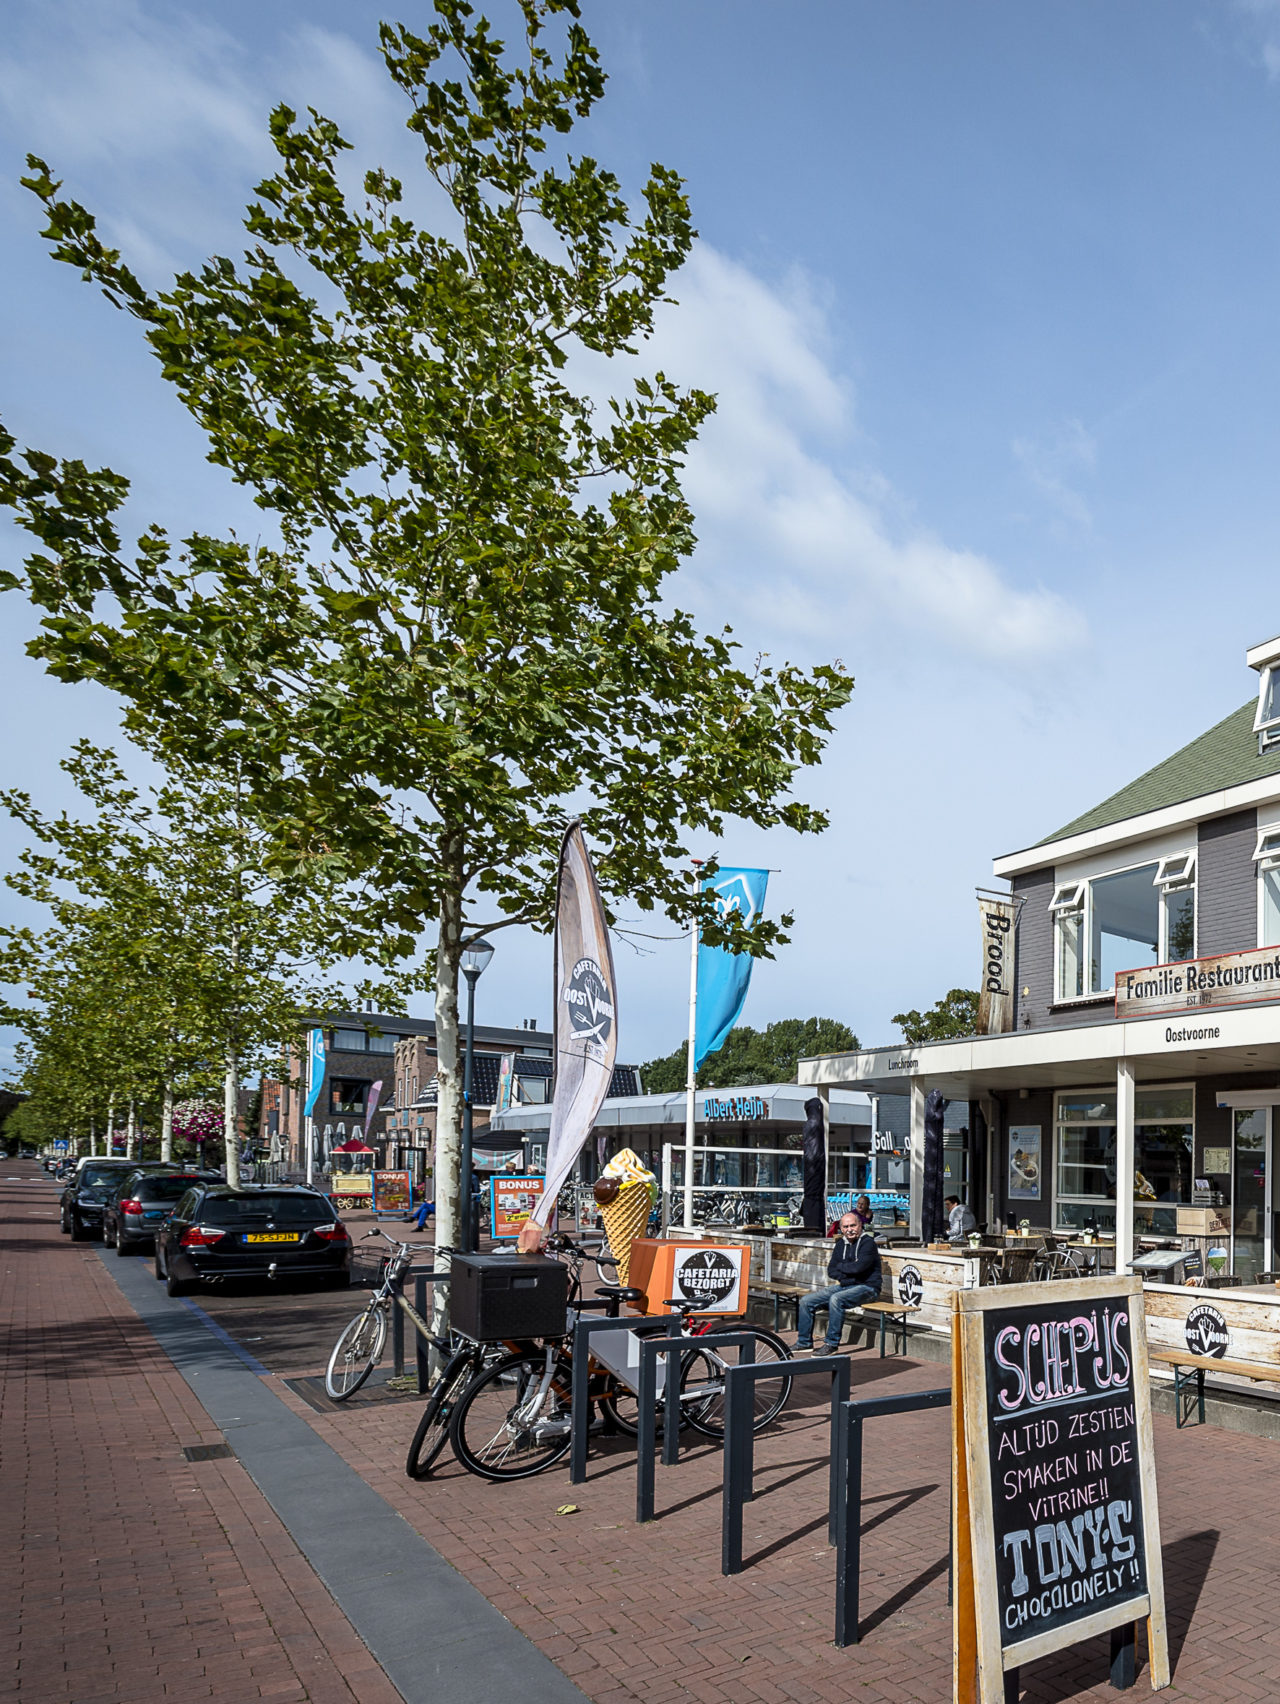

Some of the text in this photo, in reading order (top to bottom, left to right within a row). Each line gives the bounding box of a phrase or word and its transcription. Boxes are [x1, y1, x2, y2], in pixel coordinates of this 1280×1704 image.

[986, 912, 1011, 997] Brood
[573, 959, 607, 992] CAFETARIA
[1126, 969, 1183, 1000] Familie
[1165, 1026, 1220, 1043] Oostvoorne
[888, 1057, 919, 1071] Lunchroom
[704, 1097, 764, 1121] Albert Heijn
[498, 1180, 540, 1190] BONUS
[675, 1268, 739, 1279] CAFETARIA
[683, 1278, 732, 1290] BEZORGT
[1188, 1306, 1225, 1327] CAFETARIA
[1003, 1453, 1078, 1500] SMAKEN
[1110, 1440, 1133, 1467] DE
[1003, 1500, 1136, 1597] TONY'S
